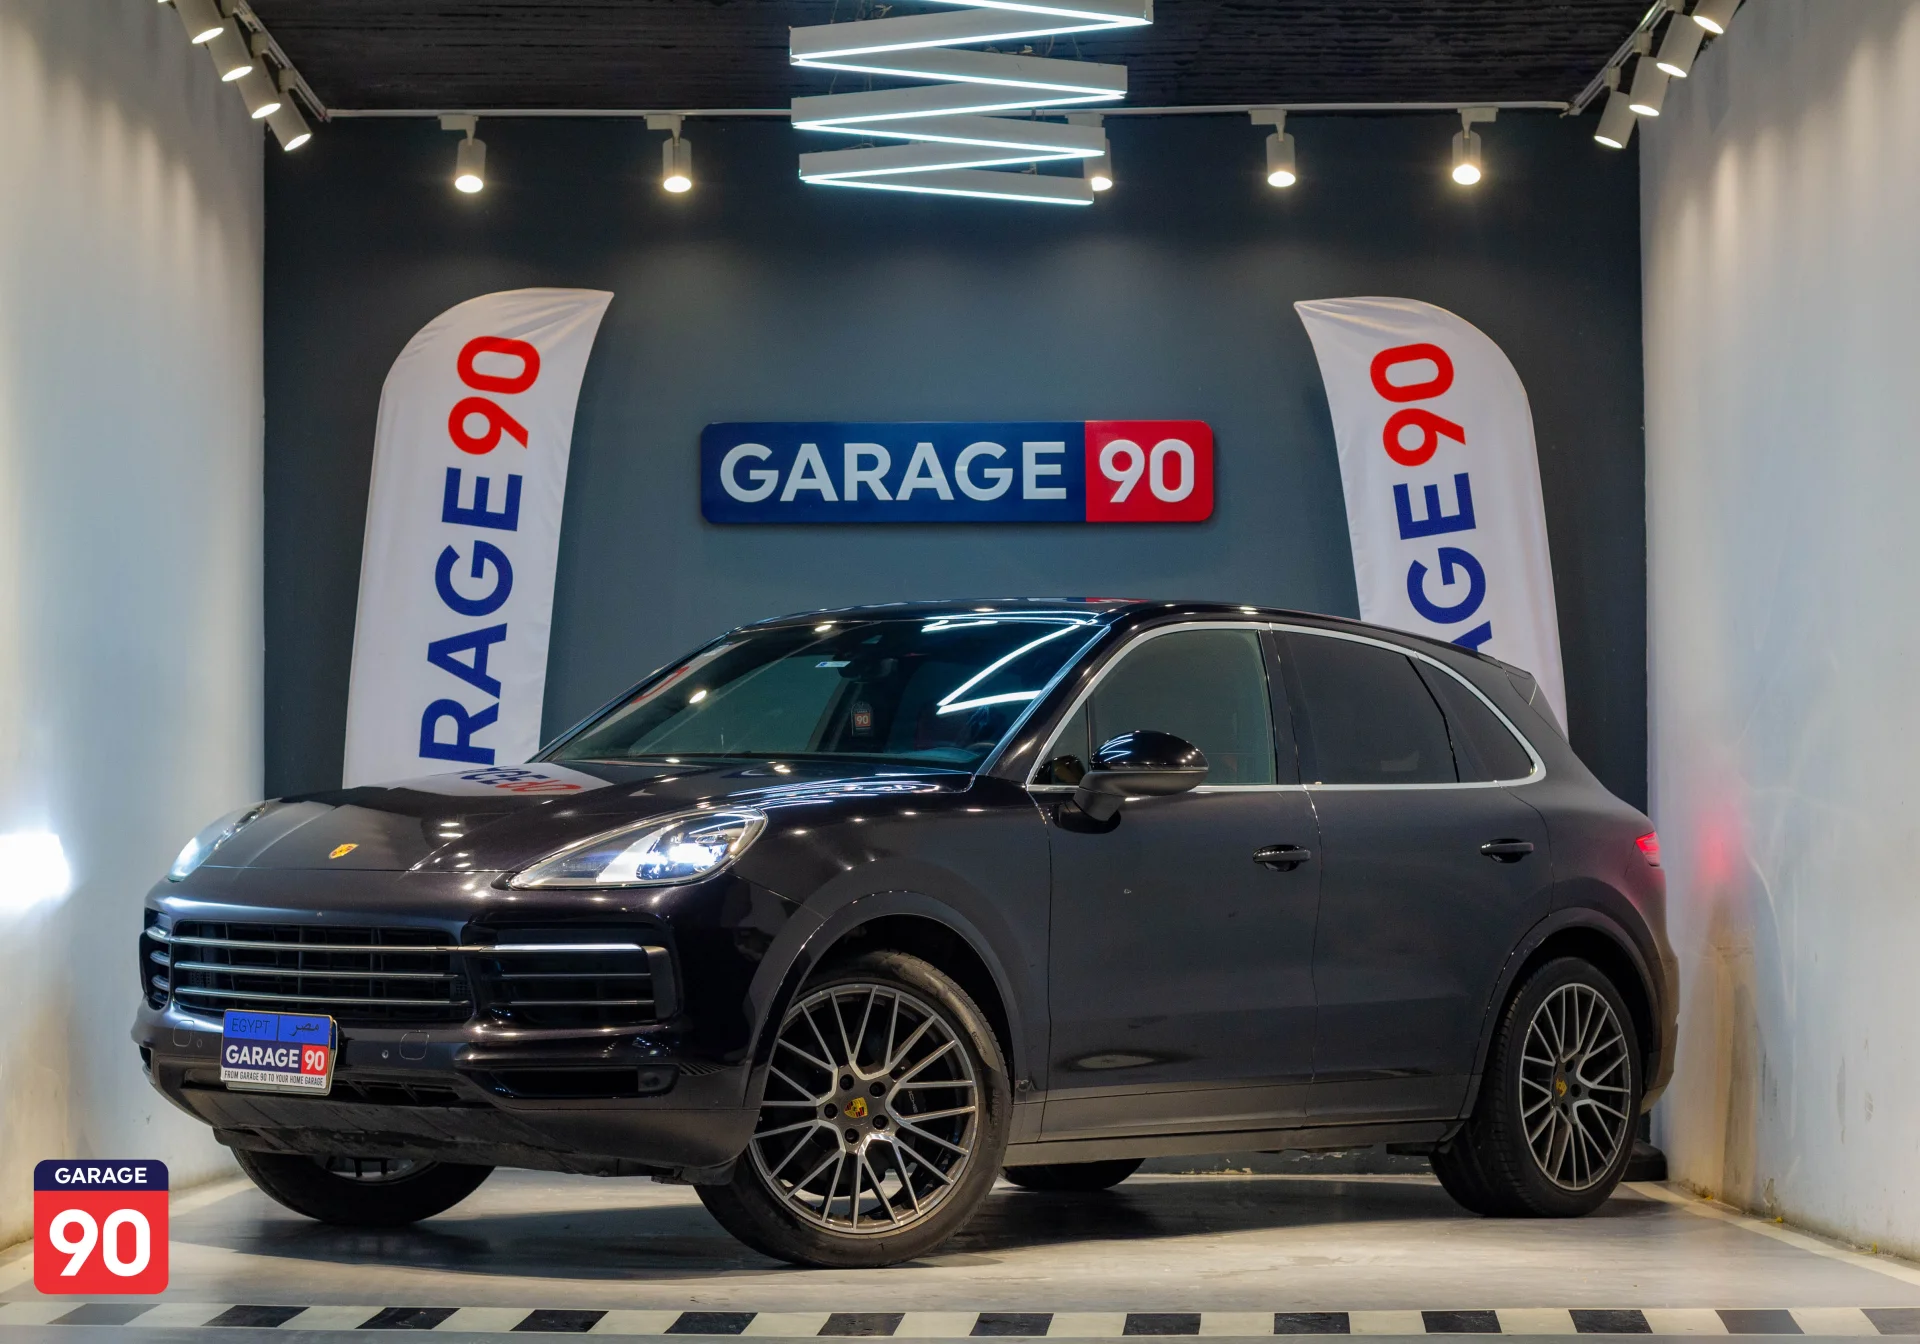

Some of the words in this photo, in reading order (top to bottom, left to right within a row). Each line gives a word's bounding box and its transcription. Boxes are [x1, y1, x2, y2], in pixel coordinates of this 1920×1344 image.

[447, 335, 541, 456] 90
[1369, 342, 1466, 467] 90
[719, 441, 1067, 503] GARAGE
[1099, 438, 1195, 503] 90
[231, 1017, 270, 1034] EGYPT
[289, 1022, 319, 1037] مصر
[225, 1044, 300, 1068] GARAGE
[304, 1050, 325, 1071] 90
[224, 1070, 239, 1080] FROM
[240, 1072, 259, 1081] GARAGE
[260, 1073, 267, 1081] 90
[268, 1074, 275, 1082] TO
[276, 1074, 288, 1083] YOUR
[290, 1075, 304, 1084] HOME
[304, 1076, 323, 1086] GARAGE
